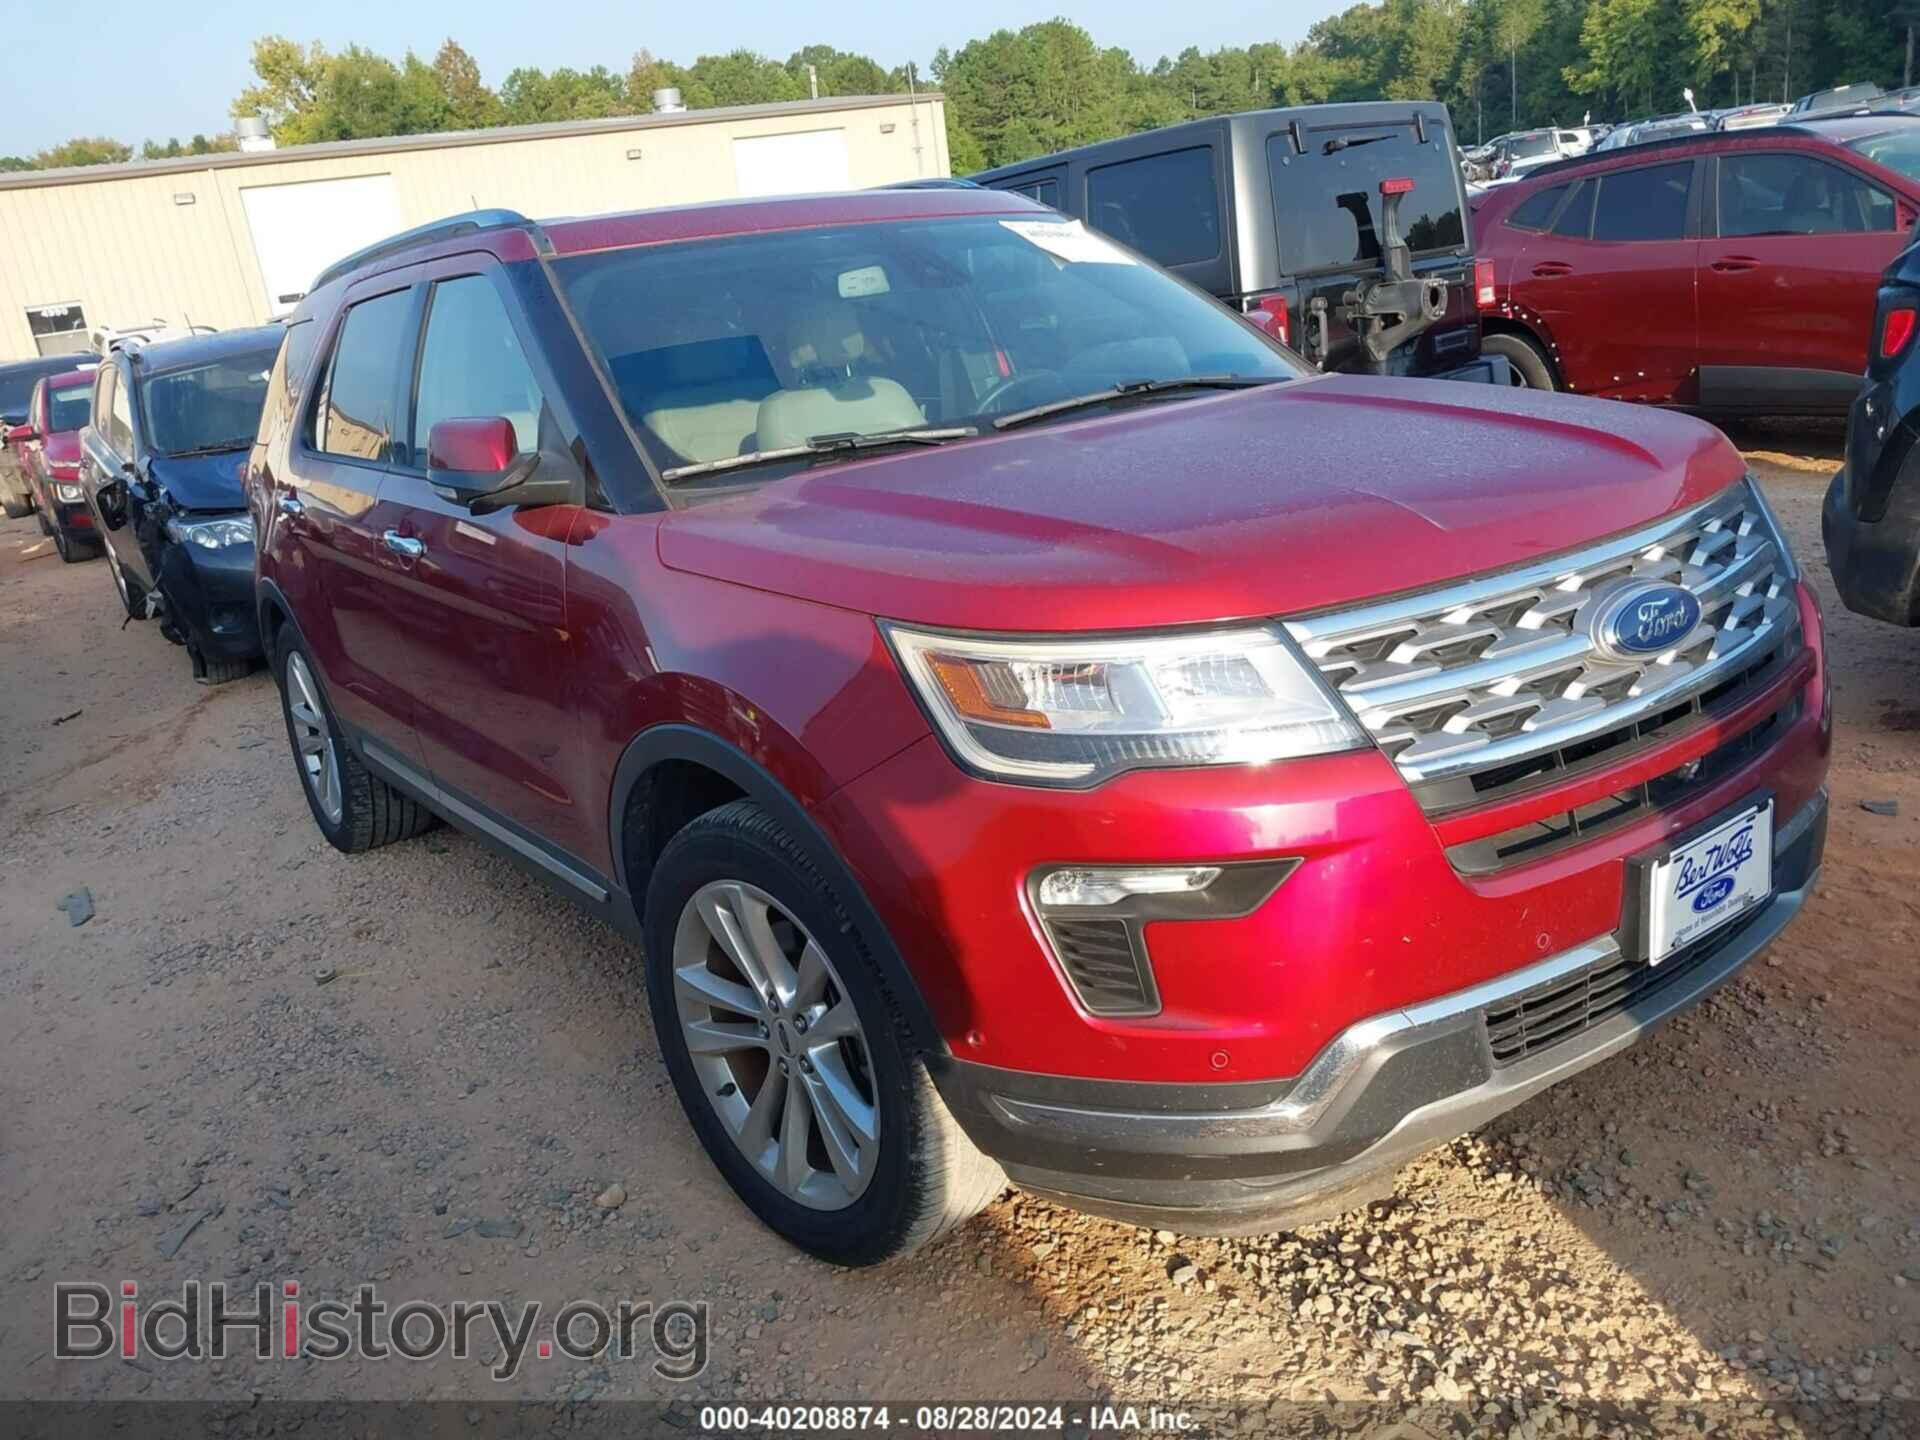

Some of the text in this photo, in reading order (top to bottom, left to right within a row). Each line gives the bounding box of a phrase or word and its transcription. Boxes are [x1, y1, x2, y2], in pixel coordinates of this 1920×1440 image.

[1637, 597, 1689, 642] Ford
[1674, 825, 1753, 894] Bert Wolfe
[1700, 881, 1728, 908] Ford
